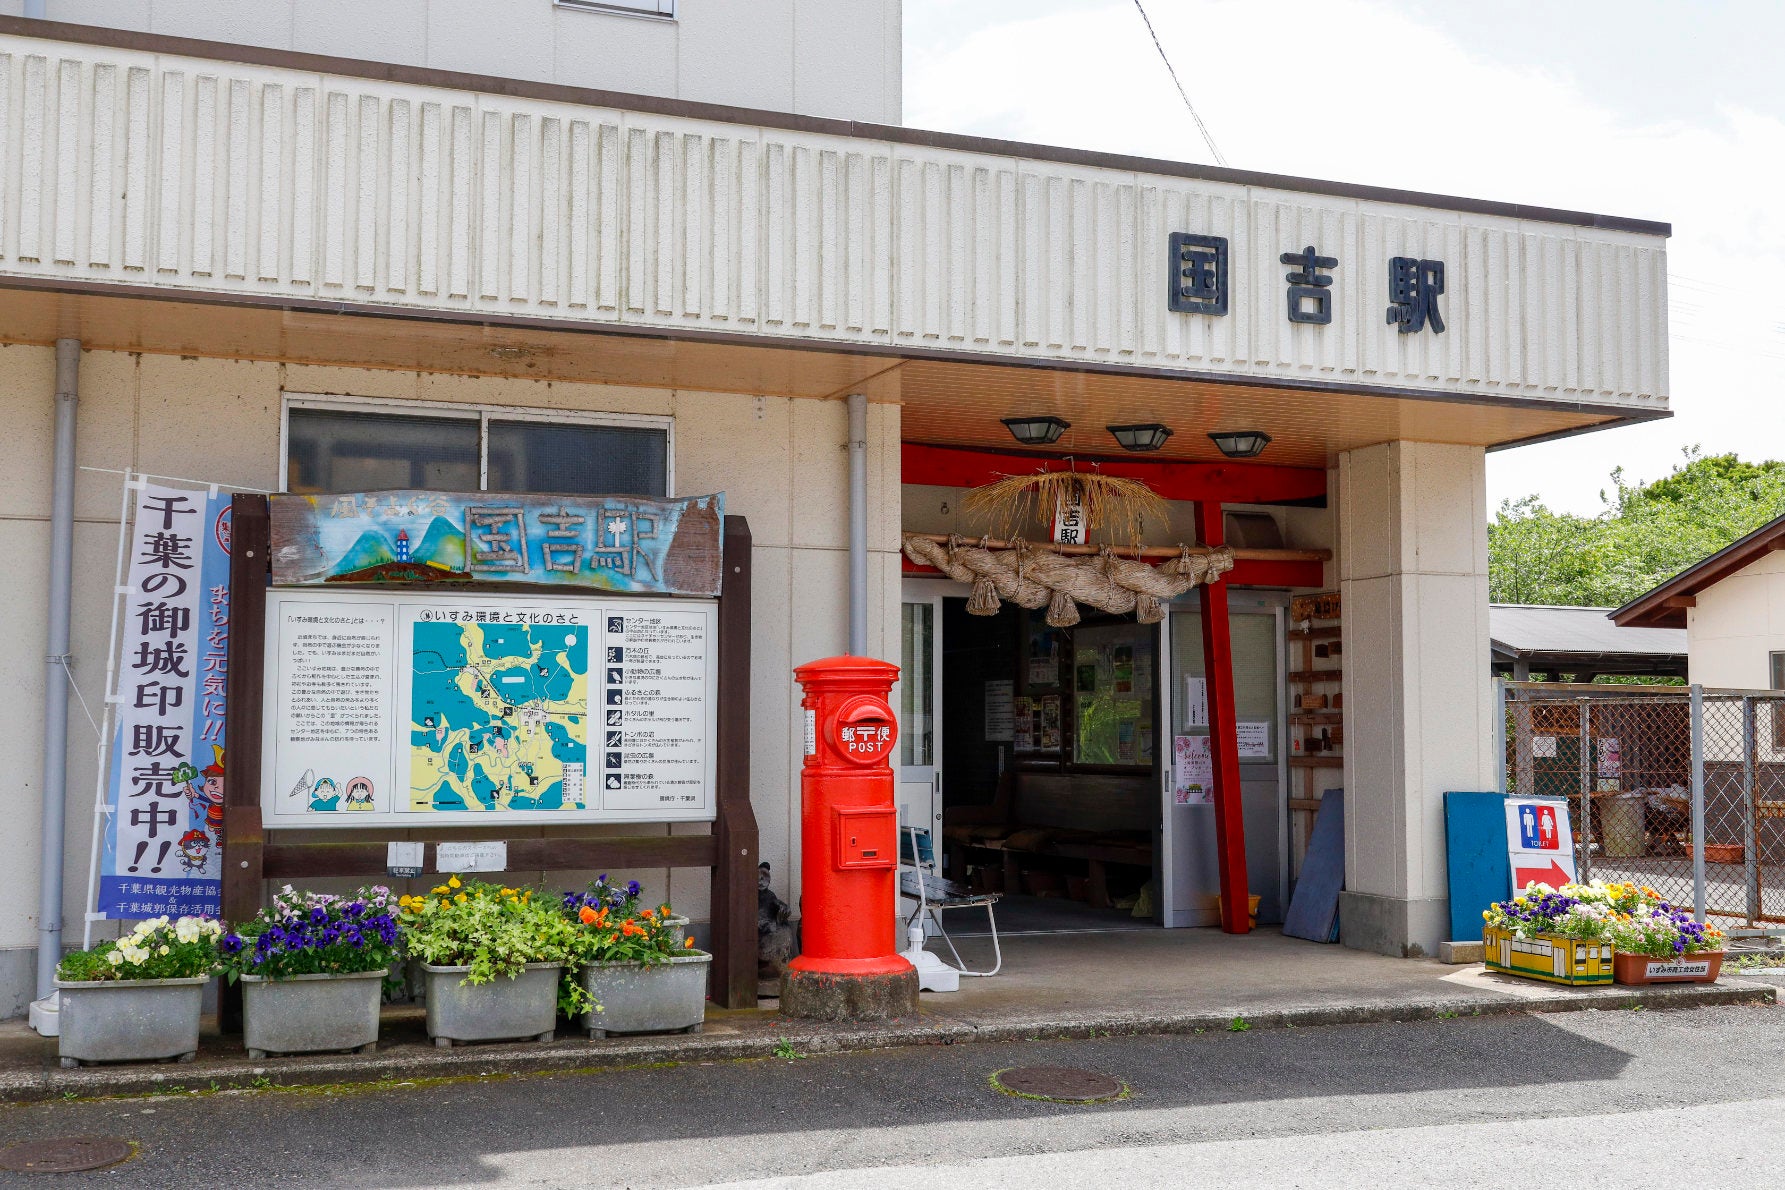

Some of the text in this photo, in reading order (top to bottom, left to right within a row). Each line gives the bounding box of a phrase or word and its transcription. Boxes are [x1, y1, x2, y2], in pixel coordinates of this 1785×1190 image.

[1168, 232, 1446, 334] 国吉駅
[331, 494, 449, 519] 風そよぐ谷
[464, 505, 659, 581] 国吉駅
[435, 610, 579, 625] いすみ環境と文化のさと
[128, 495, 198, 873] 千葉の御城印販売中!!
[849, 742, 884, 753] POST
